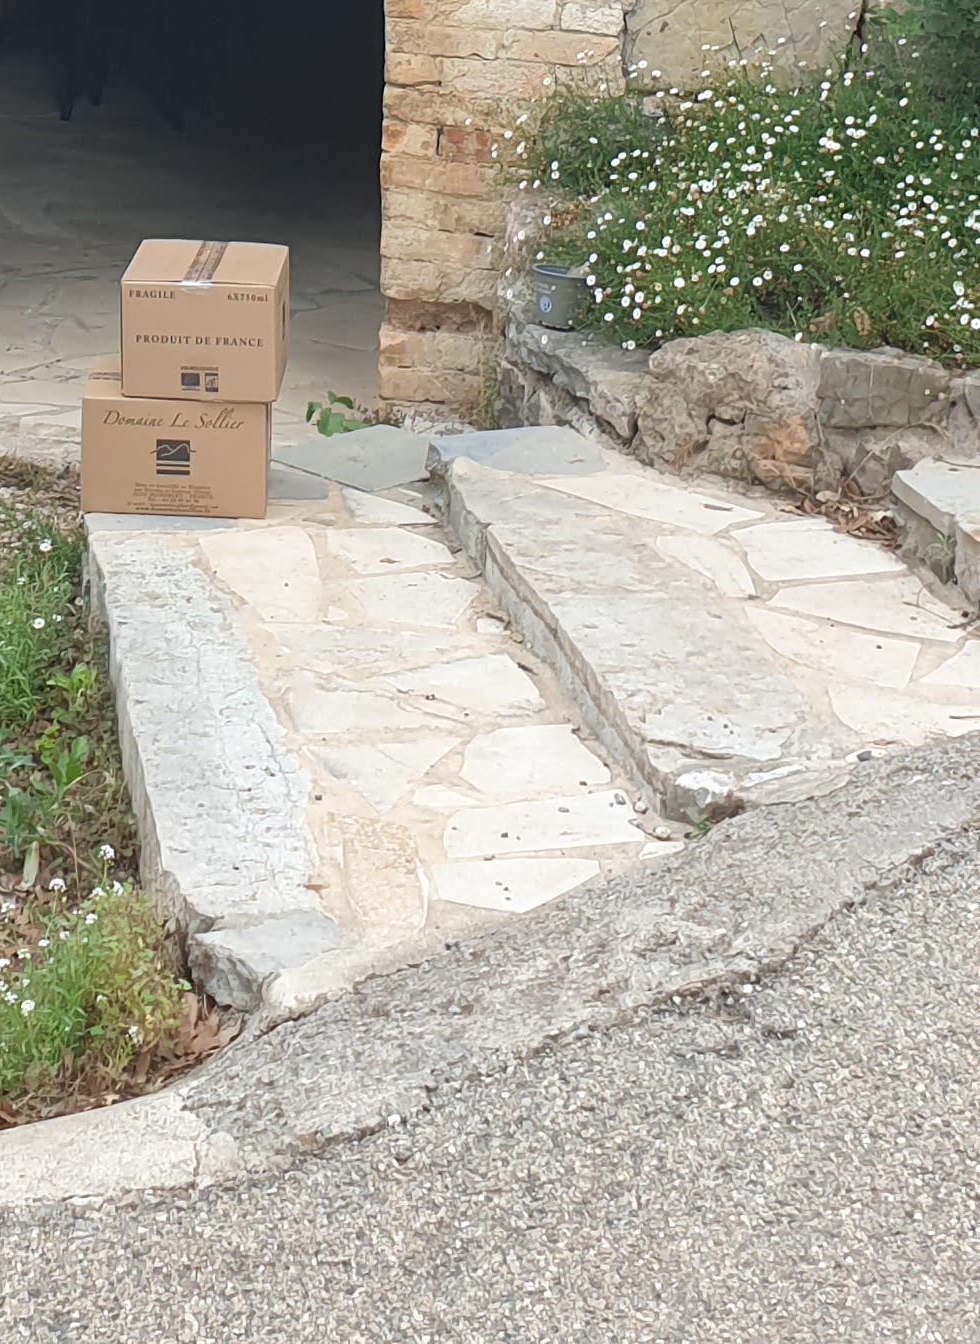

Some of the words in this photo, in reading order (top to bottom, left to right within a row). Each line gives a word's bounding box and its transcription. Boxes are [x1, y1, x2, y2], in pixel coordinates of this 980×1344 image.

[128, 289, 176, 300] FRAGILE
[135, 334, 190, 345] PRODUIT
[195, 336, 212, 346] DE
[216, 336, 264, 348] FRANCE
[102, 409, 164, 428] Domaine
[170, 413, 191, 428] Le
[194, 408, 245, 430] Sollier
